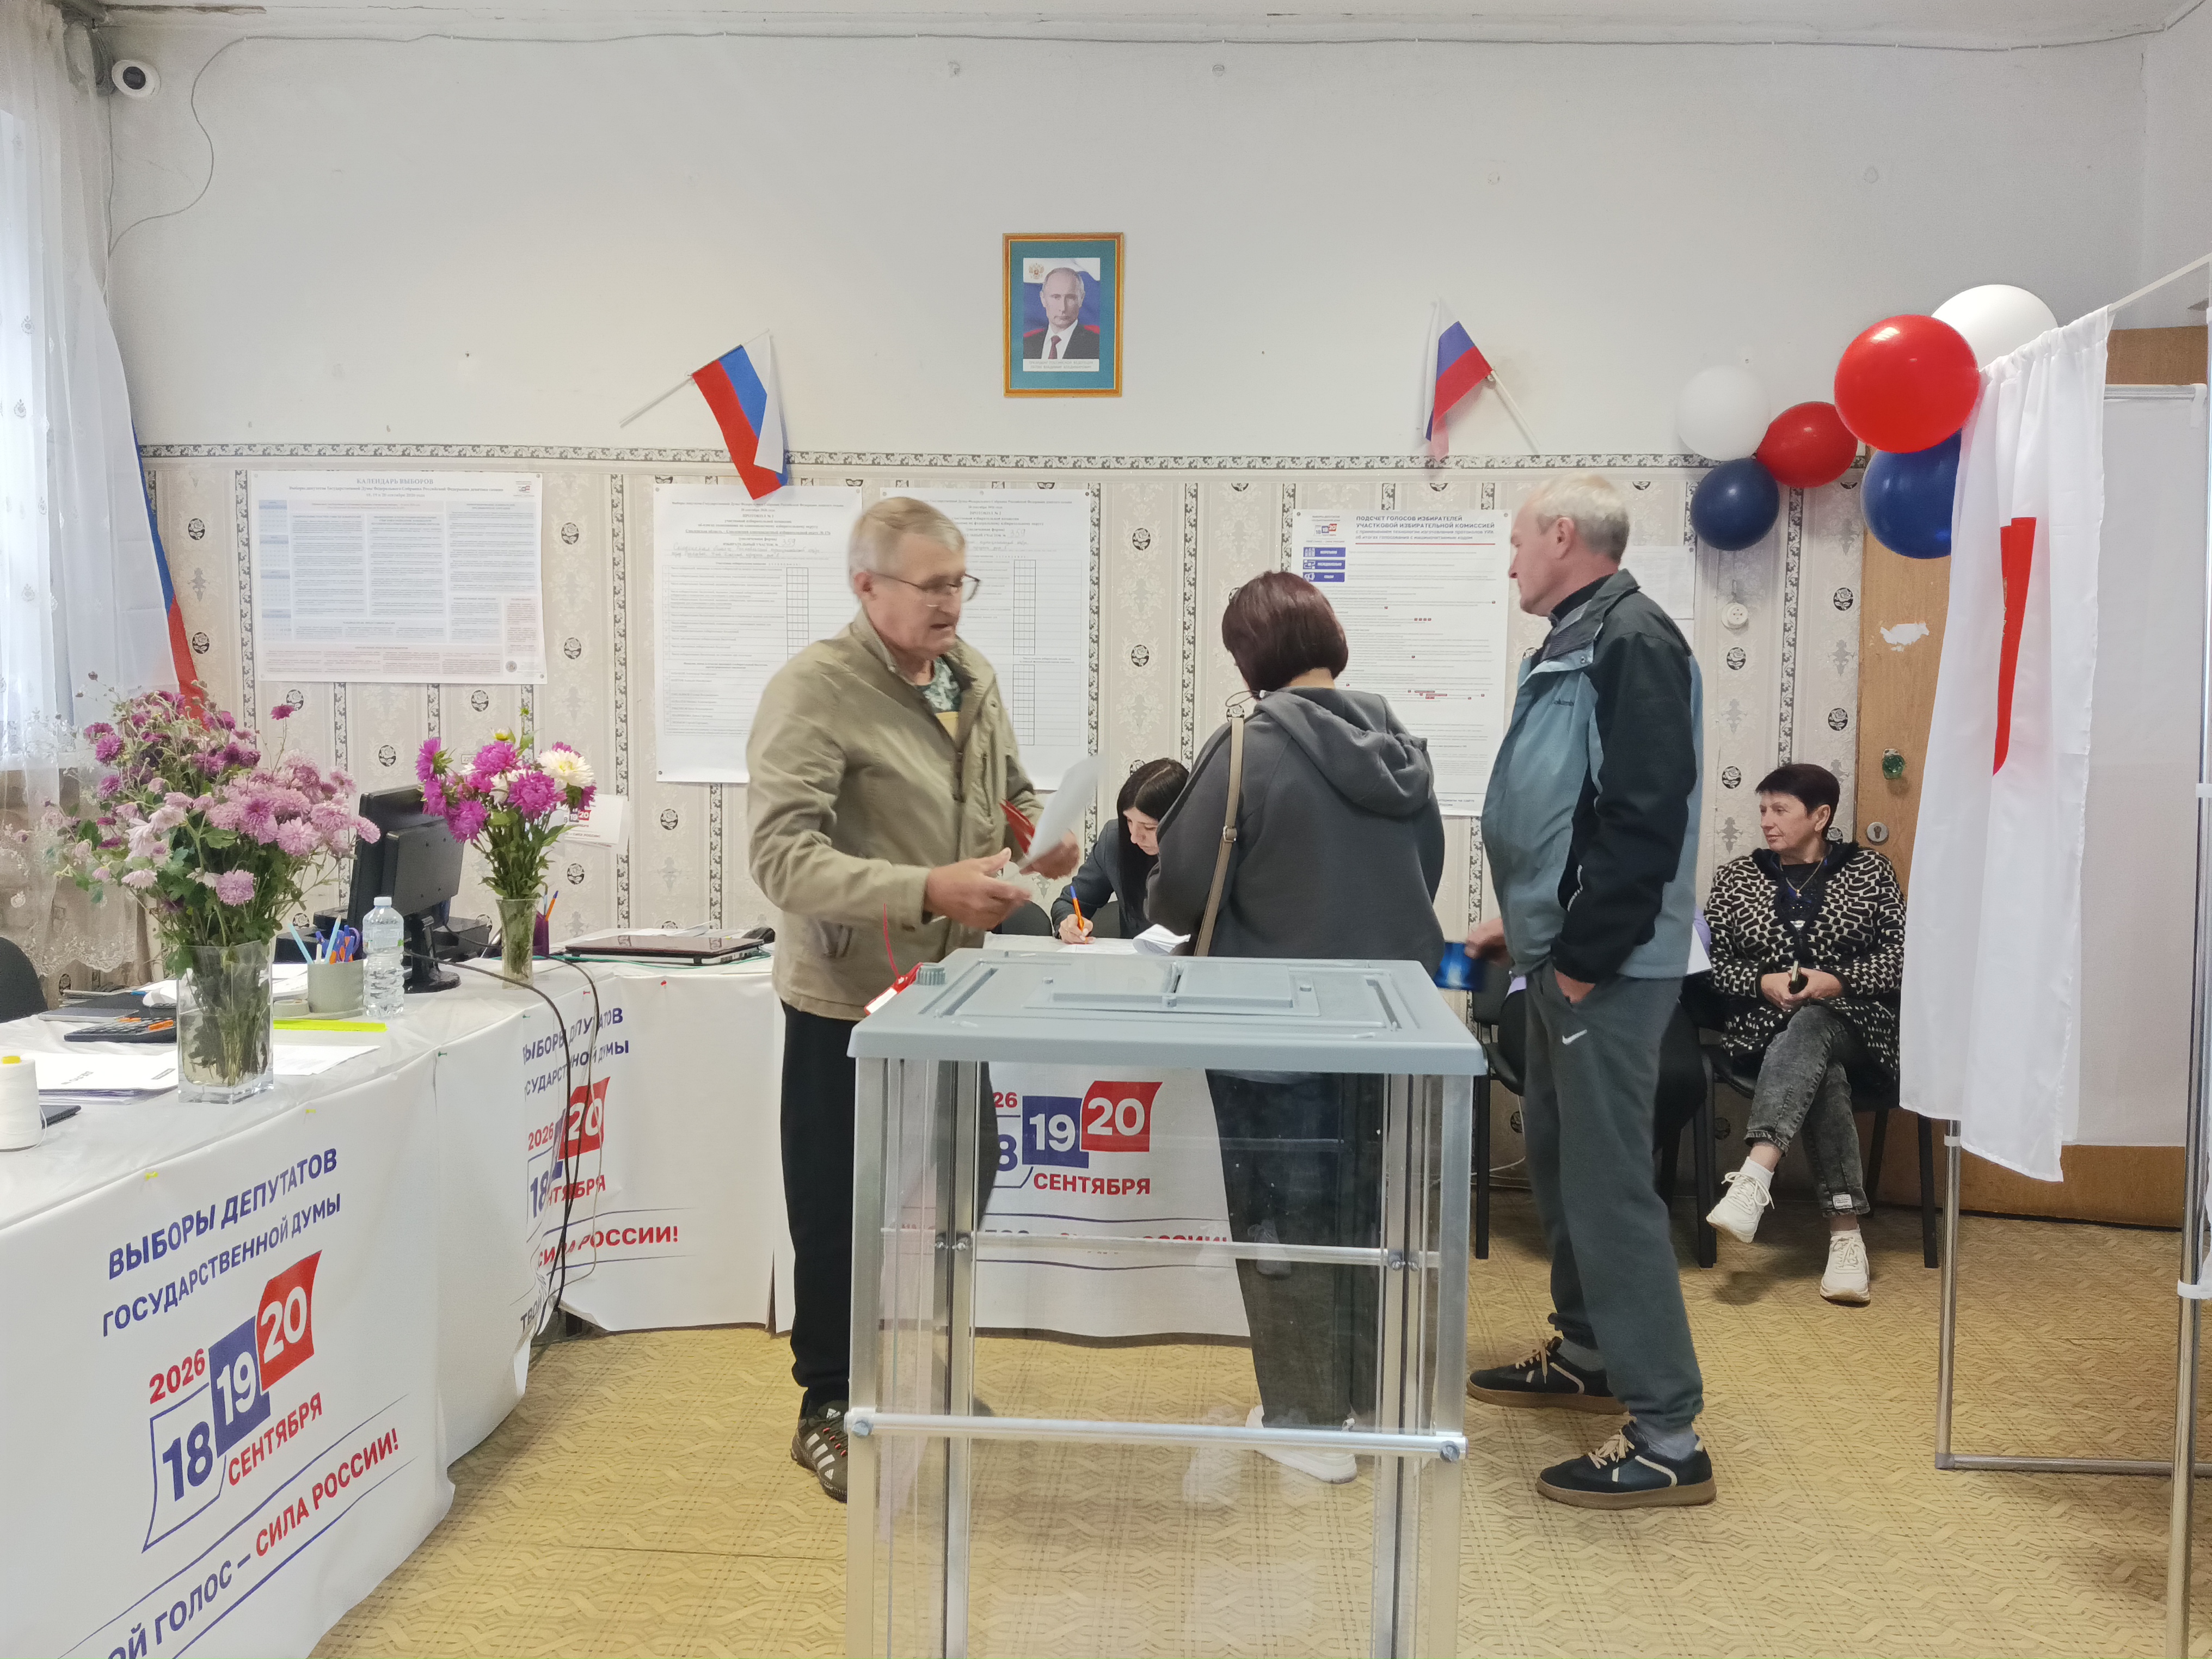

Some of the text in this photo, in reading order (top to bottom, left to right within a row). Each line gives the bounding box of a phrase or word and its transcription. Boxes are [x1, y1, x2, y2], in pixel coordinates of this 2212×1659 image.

[527, 1121, 554, 1151] 2026
[993, 1092, 1018, 1108] 26
[997, 1097, 1145, 1172] 8 19 20
[109, 1147, 337, 1280] ВЫБОРЫ ДЕПУТАТОВ
[1034, 1172, 1151, 1196] СЕНТЯБРЯ
[103, 1193, 341, 1337] ГОСУДАРСТВЕННОЙ ДУМЫ
[577, 1225, 678, 1251] РОССИИ!
[150, 1348, 206, 1405] 2026
[162, 1286, 308, 1502] 18 19 20
[228, 1392, 322, 1486] СЕНТЯБРЯ
[155, 1560, 232, 1645] ГОЛОС
[256, 1497, 310, 1558] СИЛА
[312, 1428, 398, 1510] РОССИИ!
